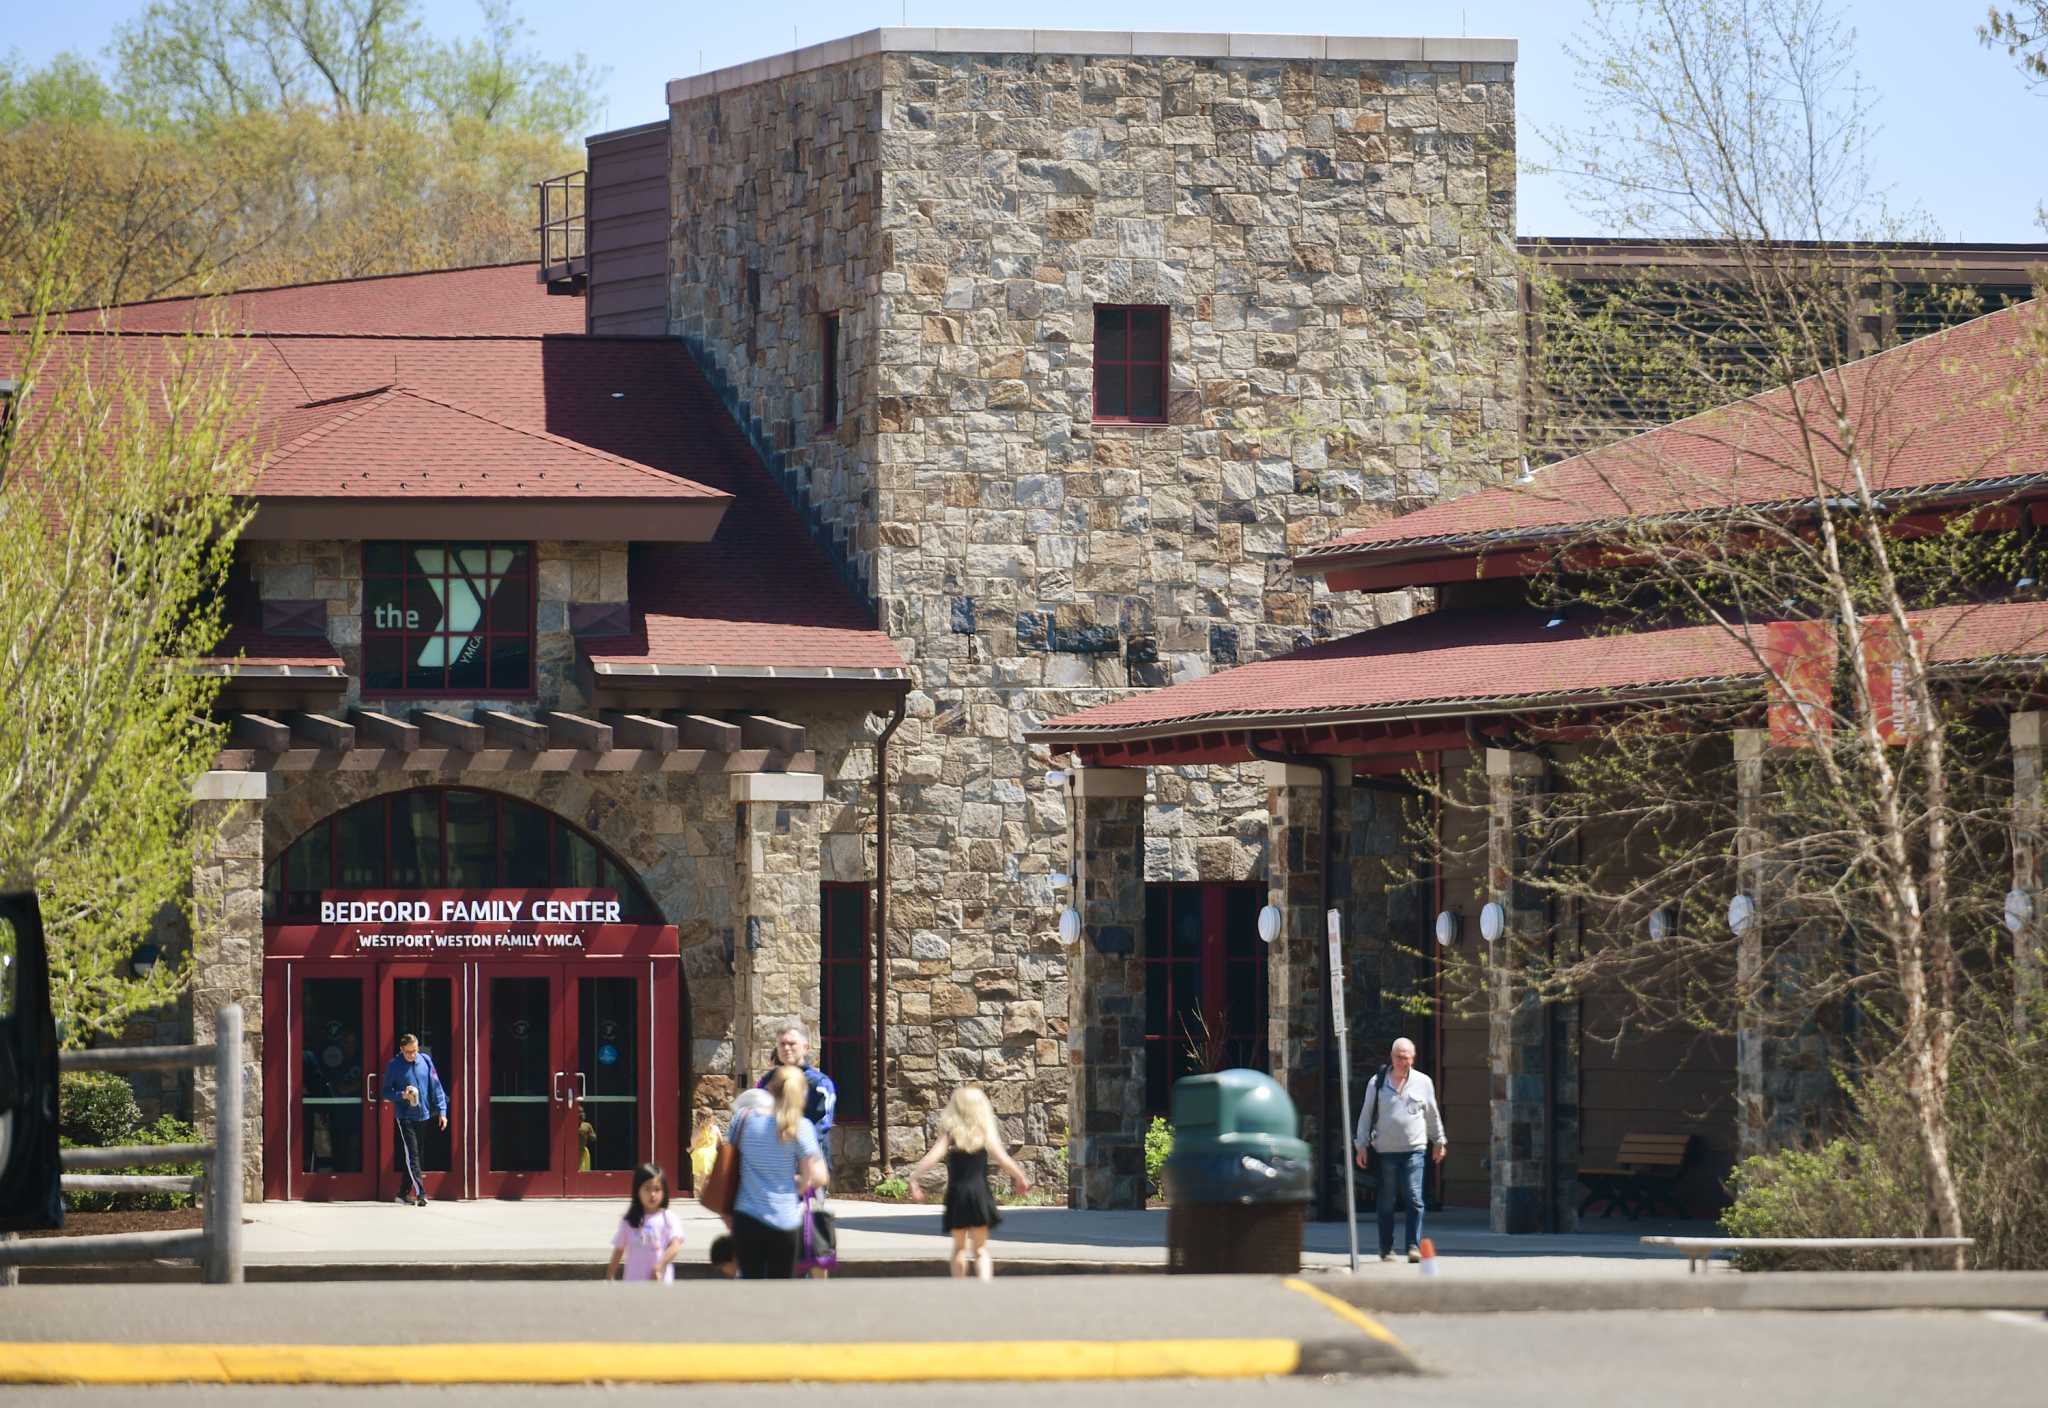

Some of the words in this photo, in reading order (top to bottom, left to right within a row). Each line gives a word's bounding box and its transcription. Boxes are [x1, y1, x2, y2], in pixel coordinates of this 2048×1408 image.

[374, 603, 419, 628] the
[459, 635, 485, 664] YMCA
[320, 901, 431, 922] BEDFORD
[442, 900, 522, 922] FAMILY
[532, 900, 621, 922] CENTER
[359, 934, 432, 947] WESTPORT
[435, 934, 491, 947] WESTON
[494, 934, 542, 947] FAMILY
[544, 934, 583, 947] YMCA
